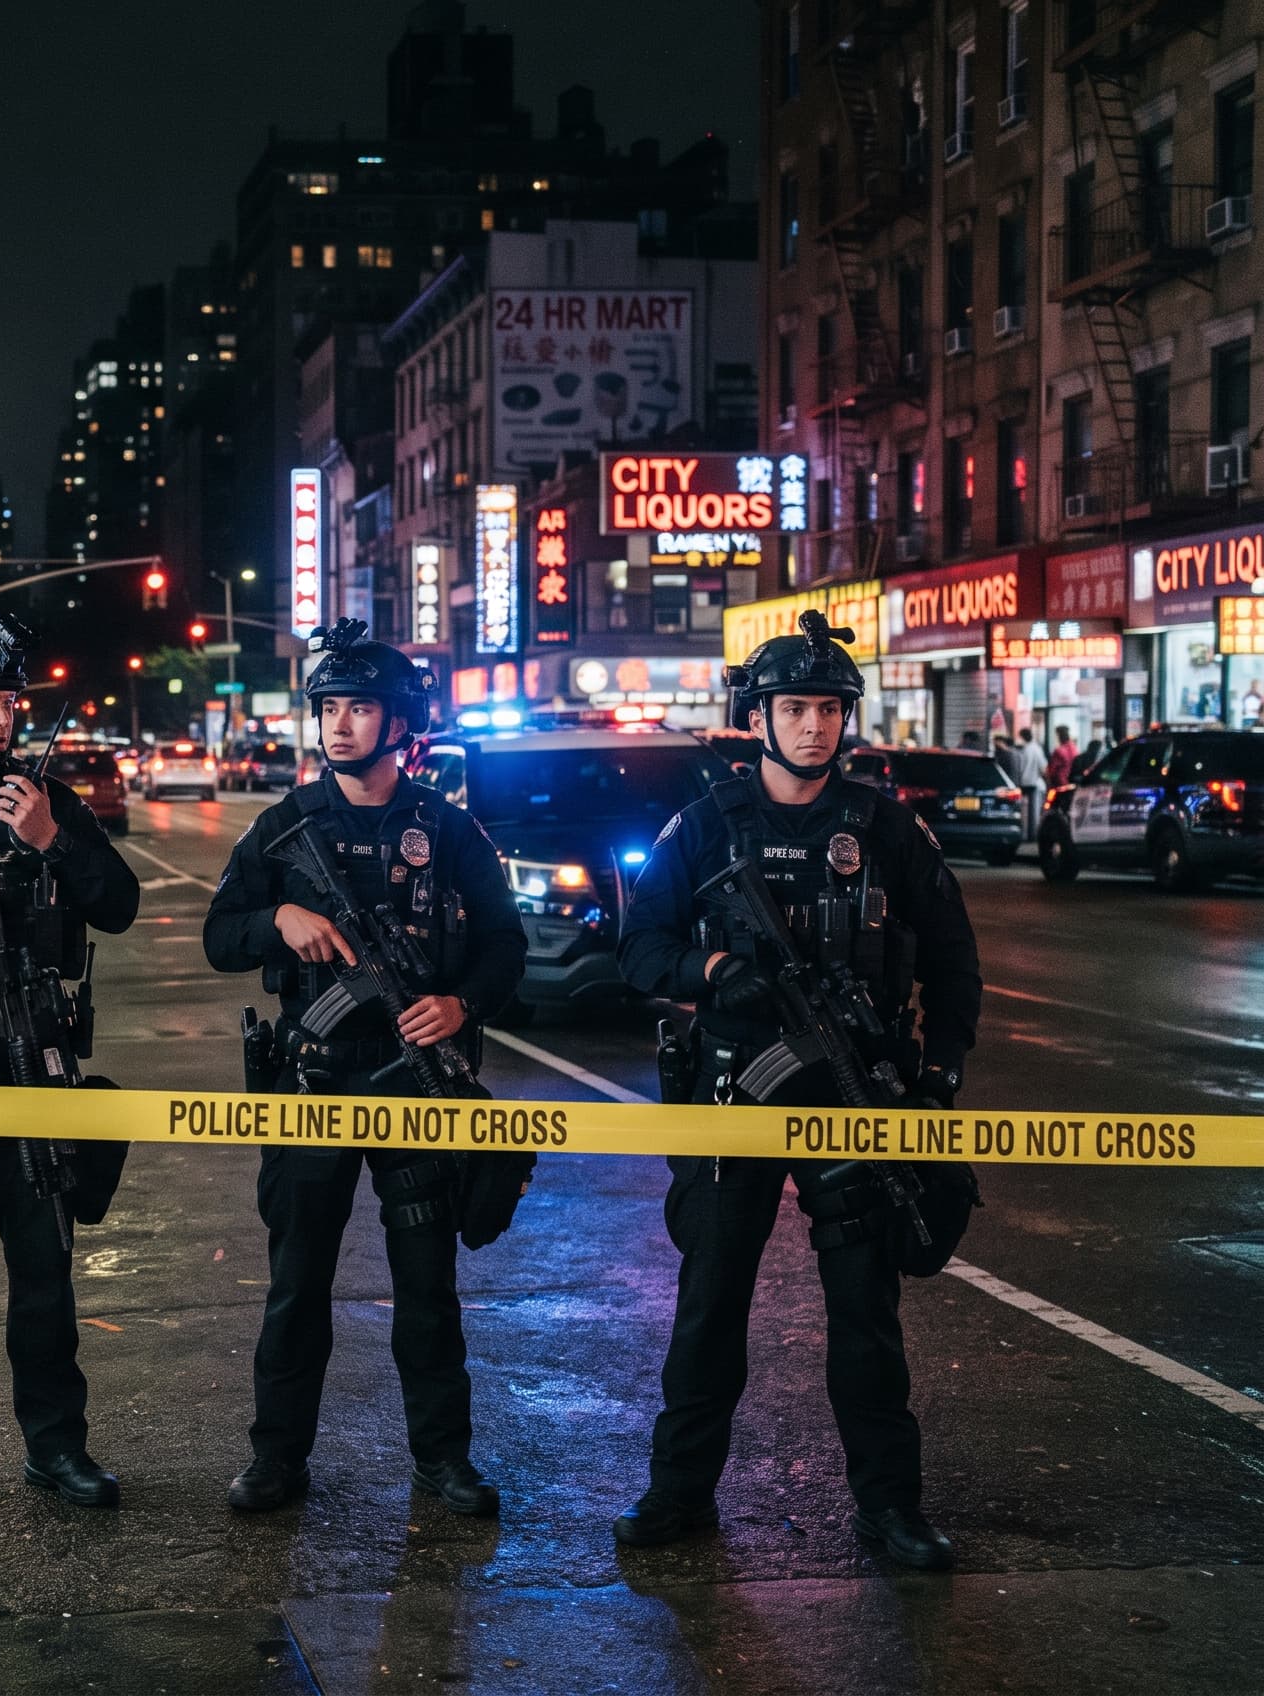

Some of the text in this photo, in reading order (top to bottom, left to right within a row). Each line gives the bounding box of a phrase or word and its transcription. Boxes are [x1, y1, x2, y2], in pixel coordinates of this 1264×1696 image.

[496, 296, 688, 331] 24 HR MART
[611, 457, 699, 493] CITY
[614, 493, 773, 531] LIQUORS
[1156, 543, 1209, 594] CITY
[904, 588, 940, 629] CITY
[942, 571, 1018, 627] LIQUORS
[169, 1100, 568, 1146] POLICE LINE DO NOT CROSS
[786, 1116, 1195, 1160] POLICE LINE DO NOT CROSS
